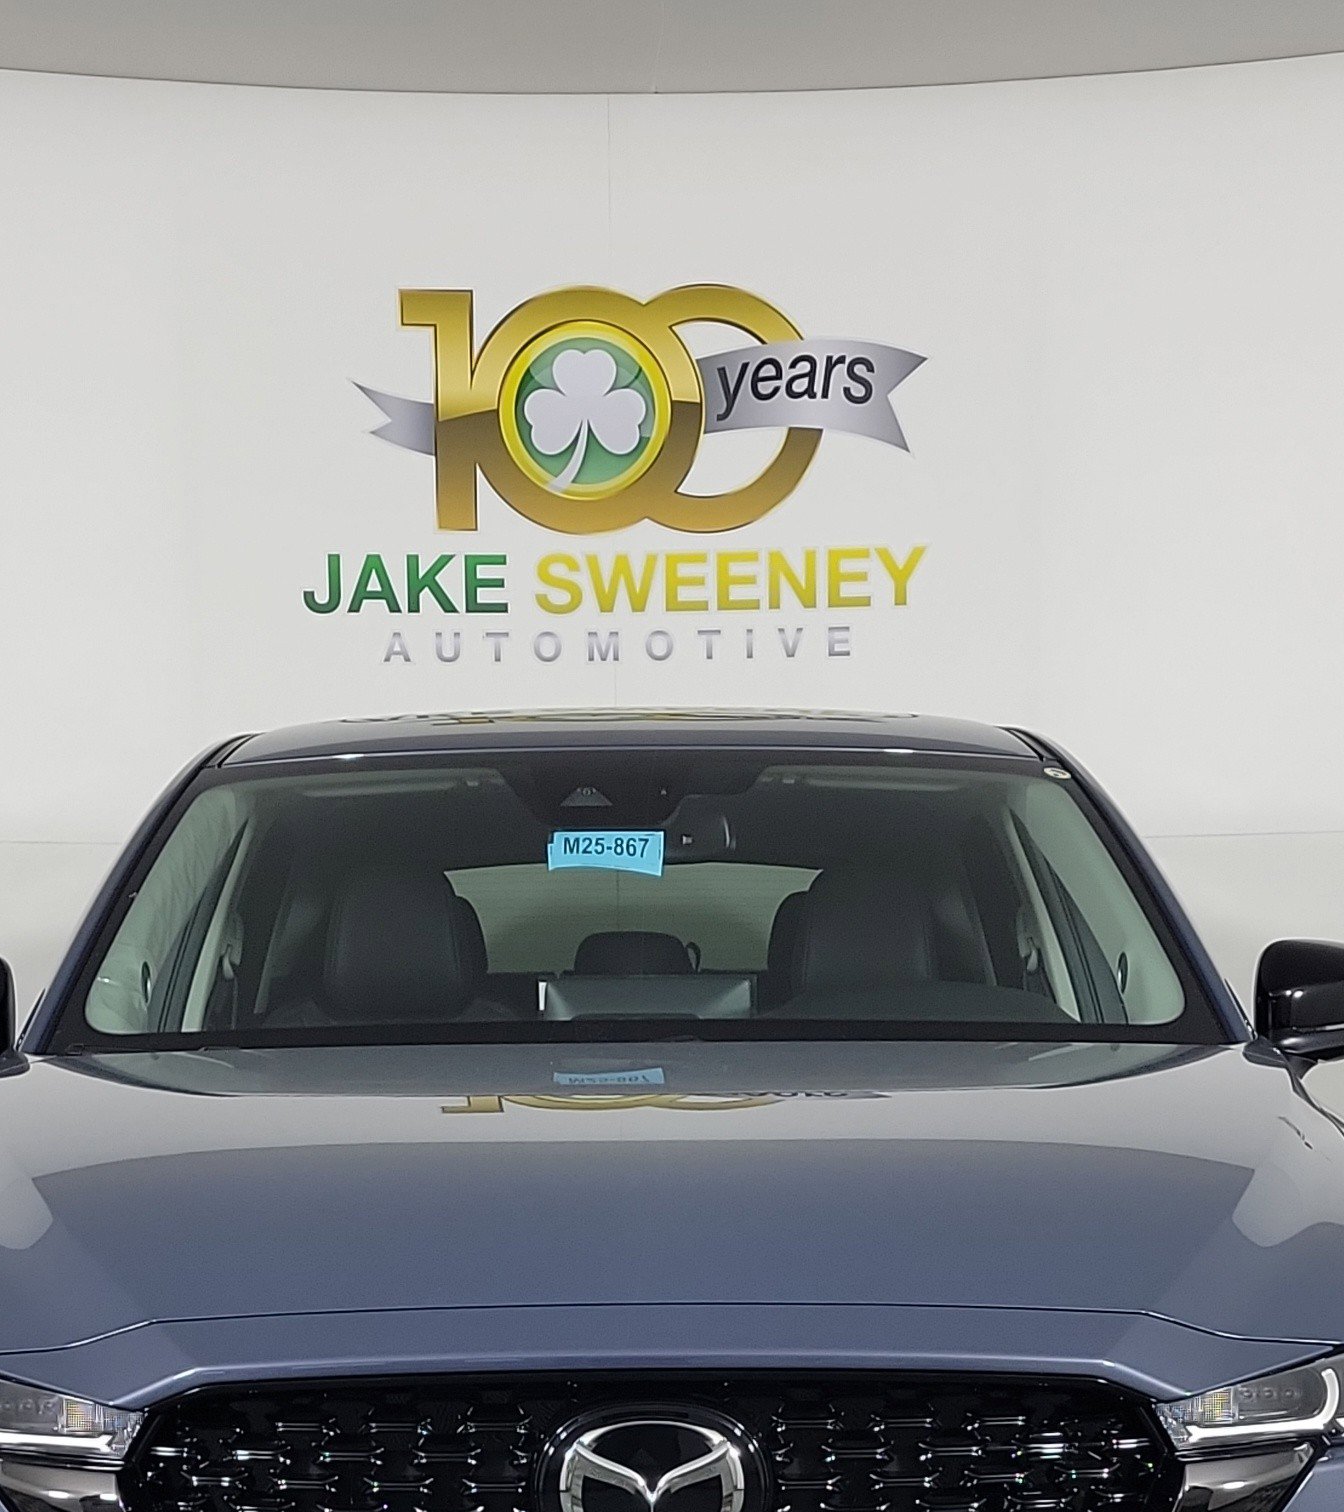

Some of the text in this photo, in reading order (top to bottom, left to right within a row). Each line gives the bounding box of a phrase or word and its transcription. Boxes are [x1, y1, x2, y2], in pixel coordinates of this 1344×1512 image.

[398, 283, 876, 535] 100 years
[302, 545, 928, 615] JAKE SWEENEY
[383, 626, 851, 663] AUTOMOTIVE
[563, 836, 650, 858] M25-867
